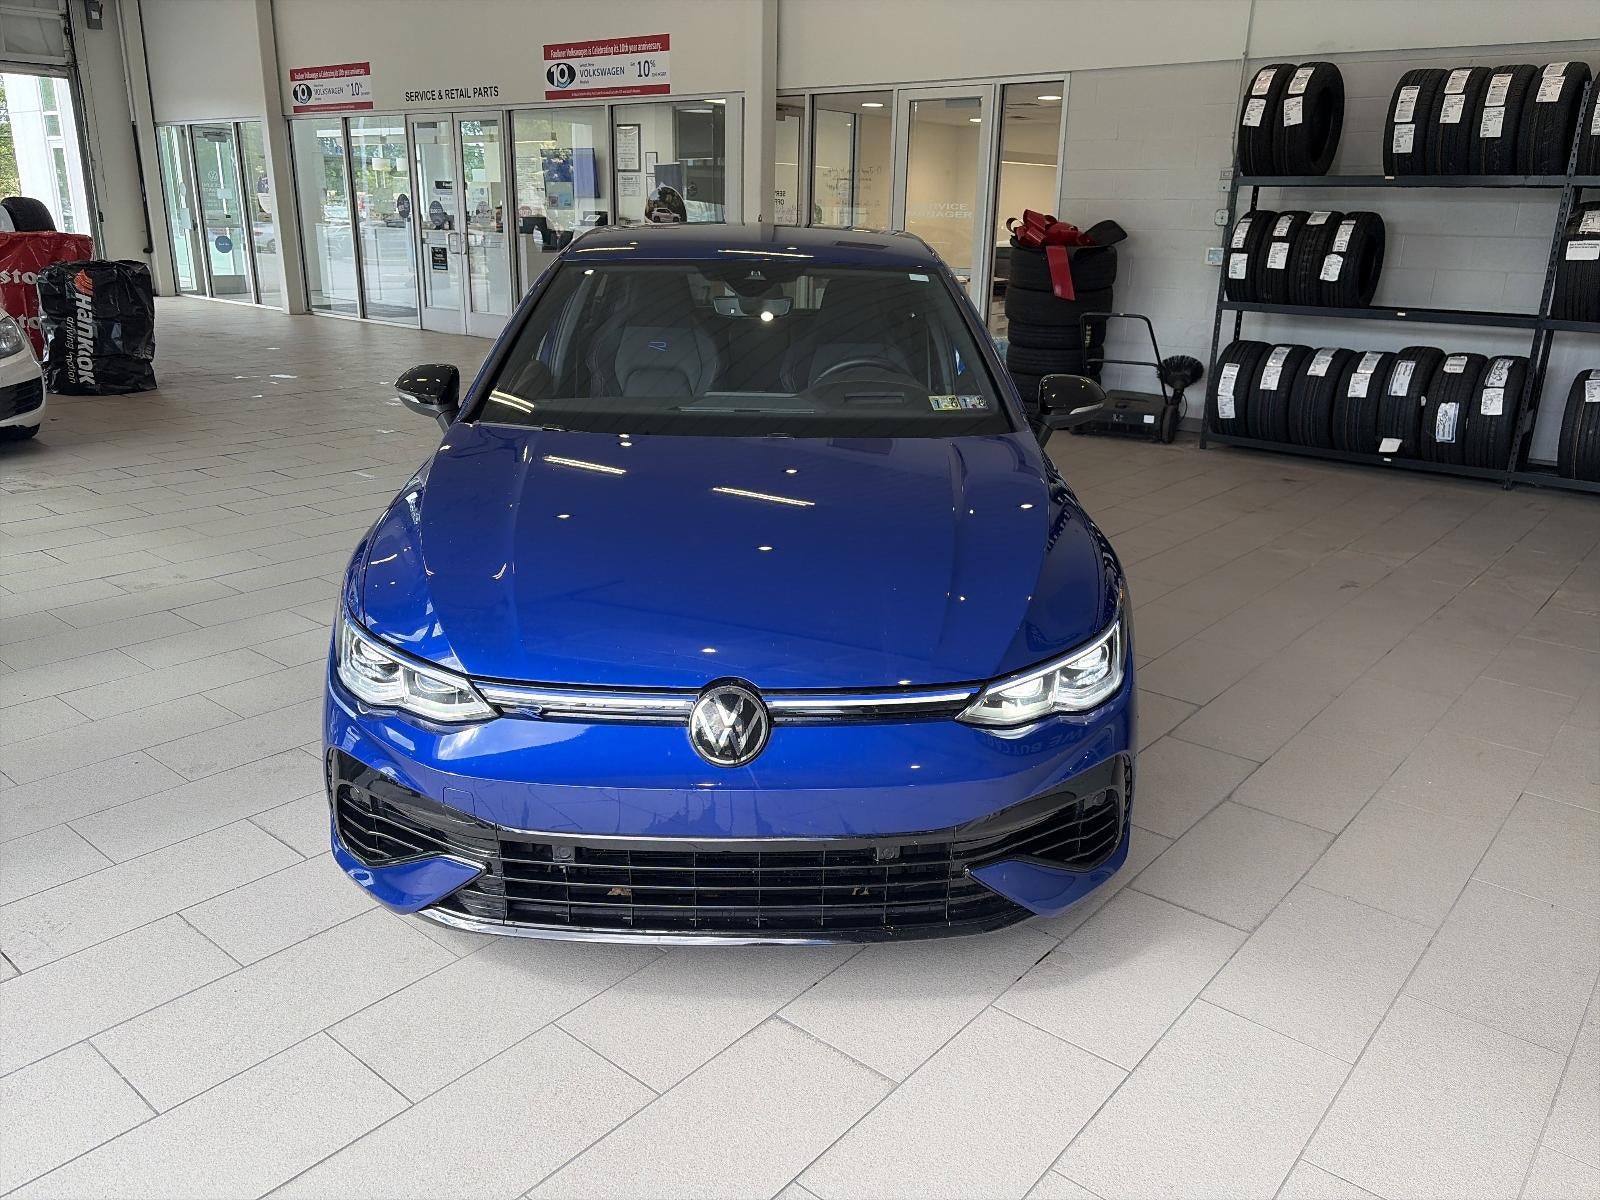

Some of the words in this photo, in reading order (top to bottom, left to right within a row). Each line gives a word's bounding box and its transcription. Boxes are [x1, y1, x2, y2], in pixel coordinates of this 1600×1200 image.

[566, 47, 587, 58] Volkswagen
[592, 44, 613, 56] Celebrating
[550, 63, 569, 87] 10
[579, 66, 625, 78] VOLKSWAGEN
[405, 90, 437, 101] SERVICE
[437, 89, 444, 100] &
[444, 87, 471, 100] RETAIL
[473, 85, 499, 98] PARTS
[65, 316, 75, 351] driving
